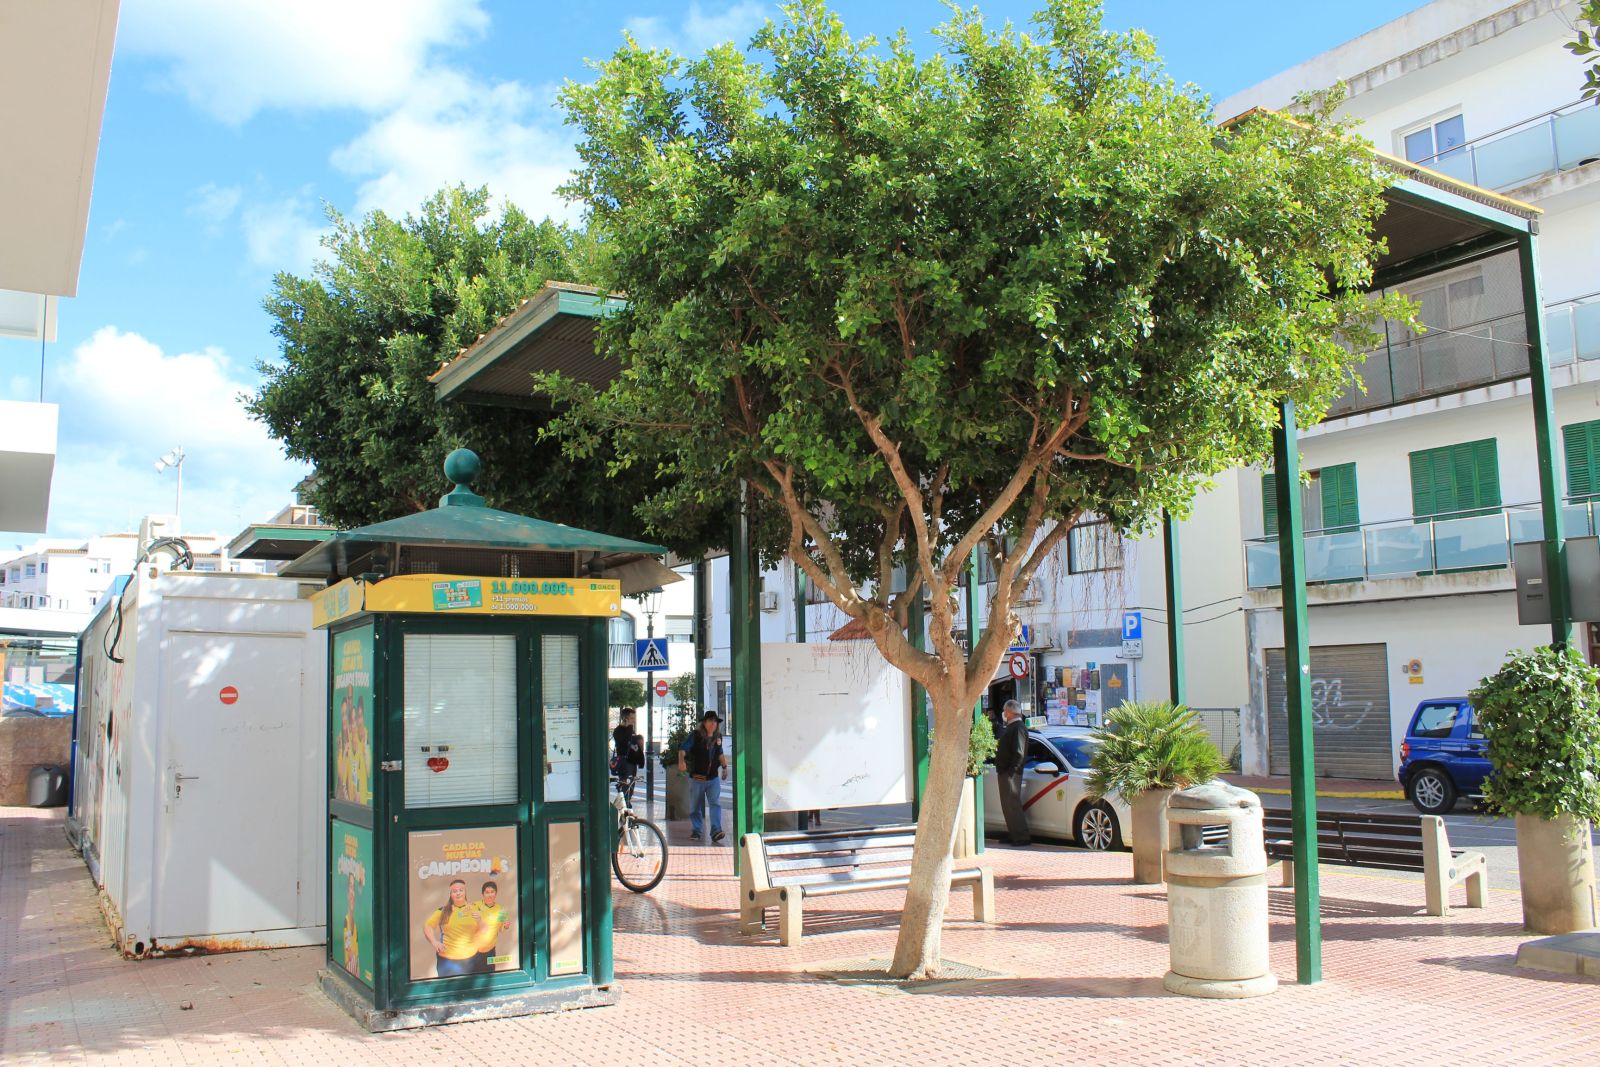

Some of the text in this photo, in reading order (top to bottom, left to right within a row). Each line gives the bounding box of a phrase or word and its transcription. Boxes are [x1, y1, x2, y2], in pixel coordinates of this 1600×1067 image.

[505, 596, 528, 604] premios
[1125, 615, 1138, 637] P
[442, 843, 467, 852] CADA
[446, 850, 482, 860] NUEVAS
